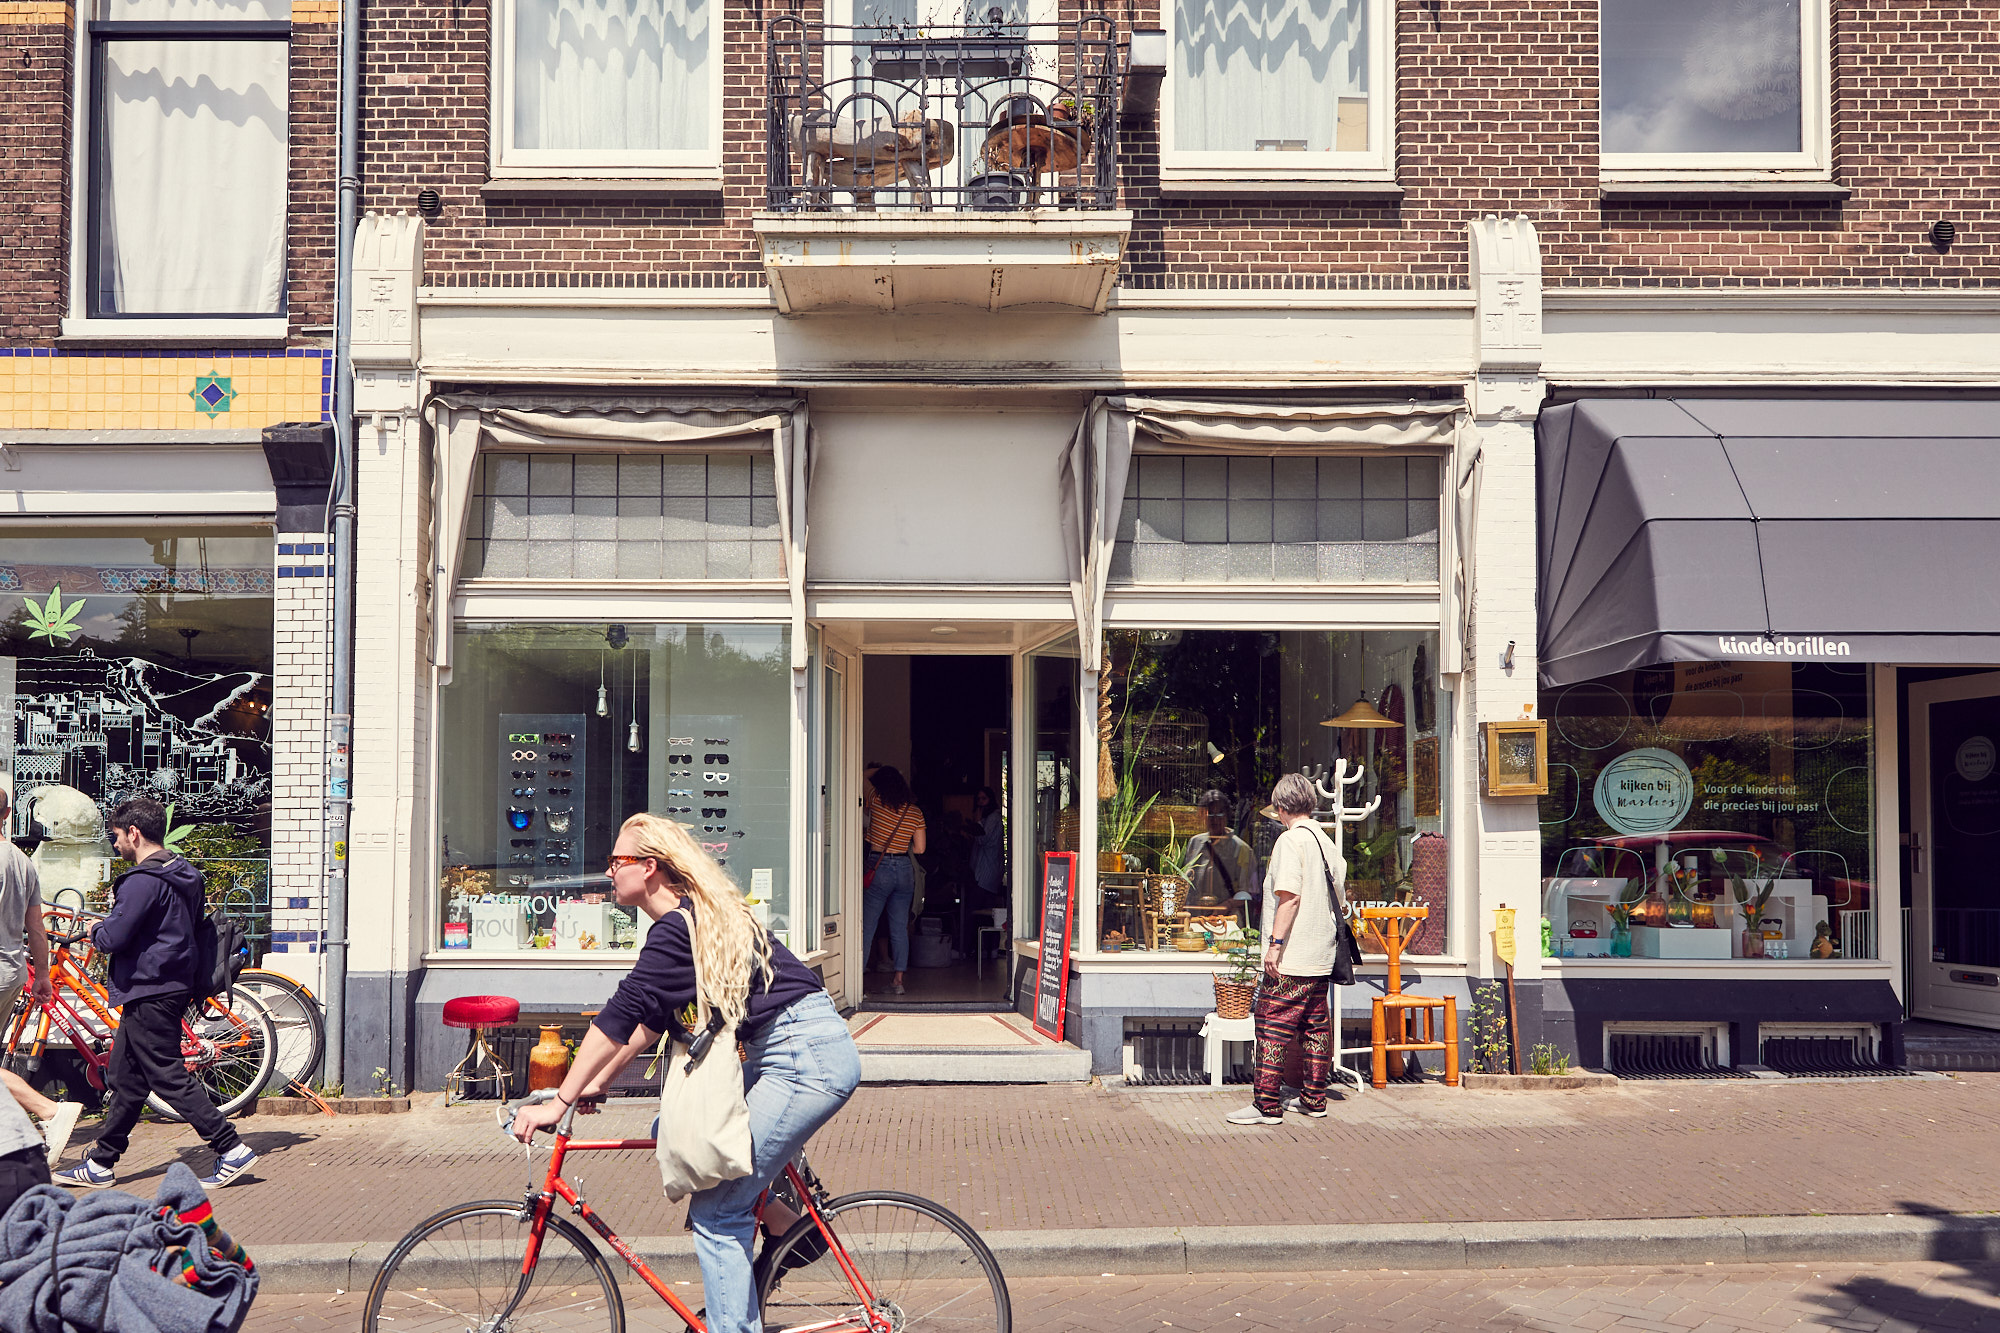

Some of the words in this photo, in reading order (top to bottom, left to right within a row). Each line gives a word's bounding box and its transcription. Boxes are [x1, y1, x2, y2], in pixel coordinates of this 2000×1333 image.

[1718, 637, 1850, 656] kinderbrillen
[1694, 680, 1712, 691] precies
[1713, 677, 1721, 688] bij
[1721, 675, 1730, 688] jou
[1731, 674, 1743, 685] past
[1620, 779, 1654, 793] kijken
[1657, 780, 1671, 793] bij
[1703, 784, 1729, 794] Voor
[1731, 784, 1743, 794] de
[1746, 785, 1797, 795] kinderbril
[1617, 795, 1676, 808] Marlies
[1703, 800, 1720, 811] die
[1722, 801, 1760, 812] precies
[1762, 801, 1775, 813] bij
[1778, 801, 1795, 813] jou
[1796, 802, 1819, 813] past
[587, 1212, 643, 1270] RALEIGH
